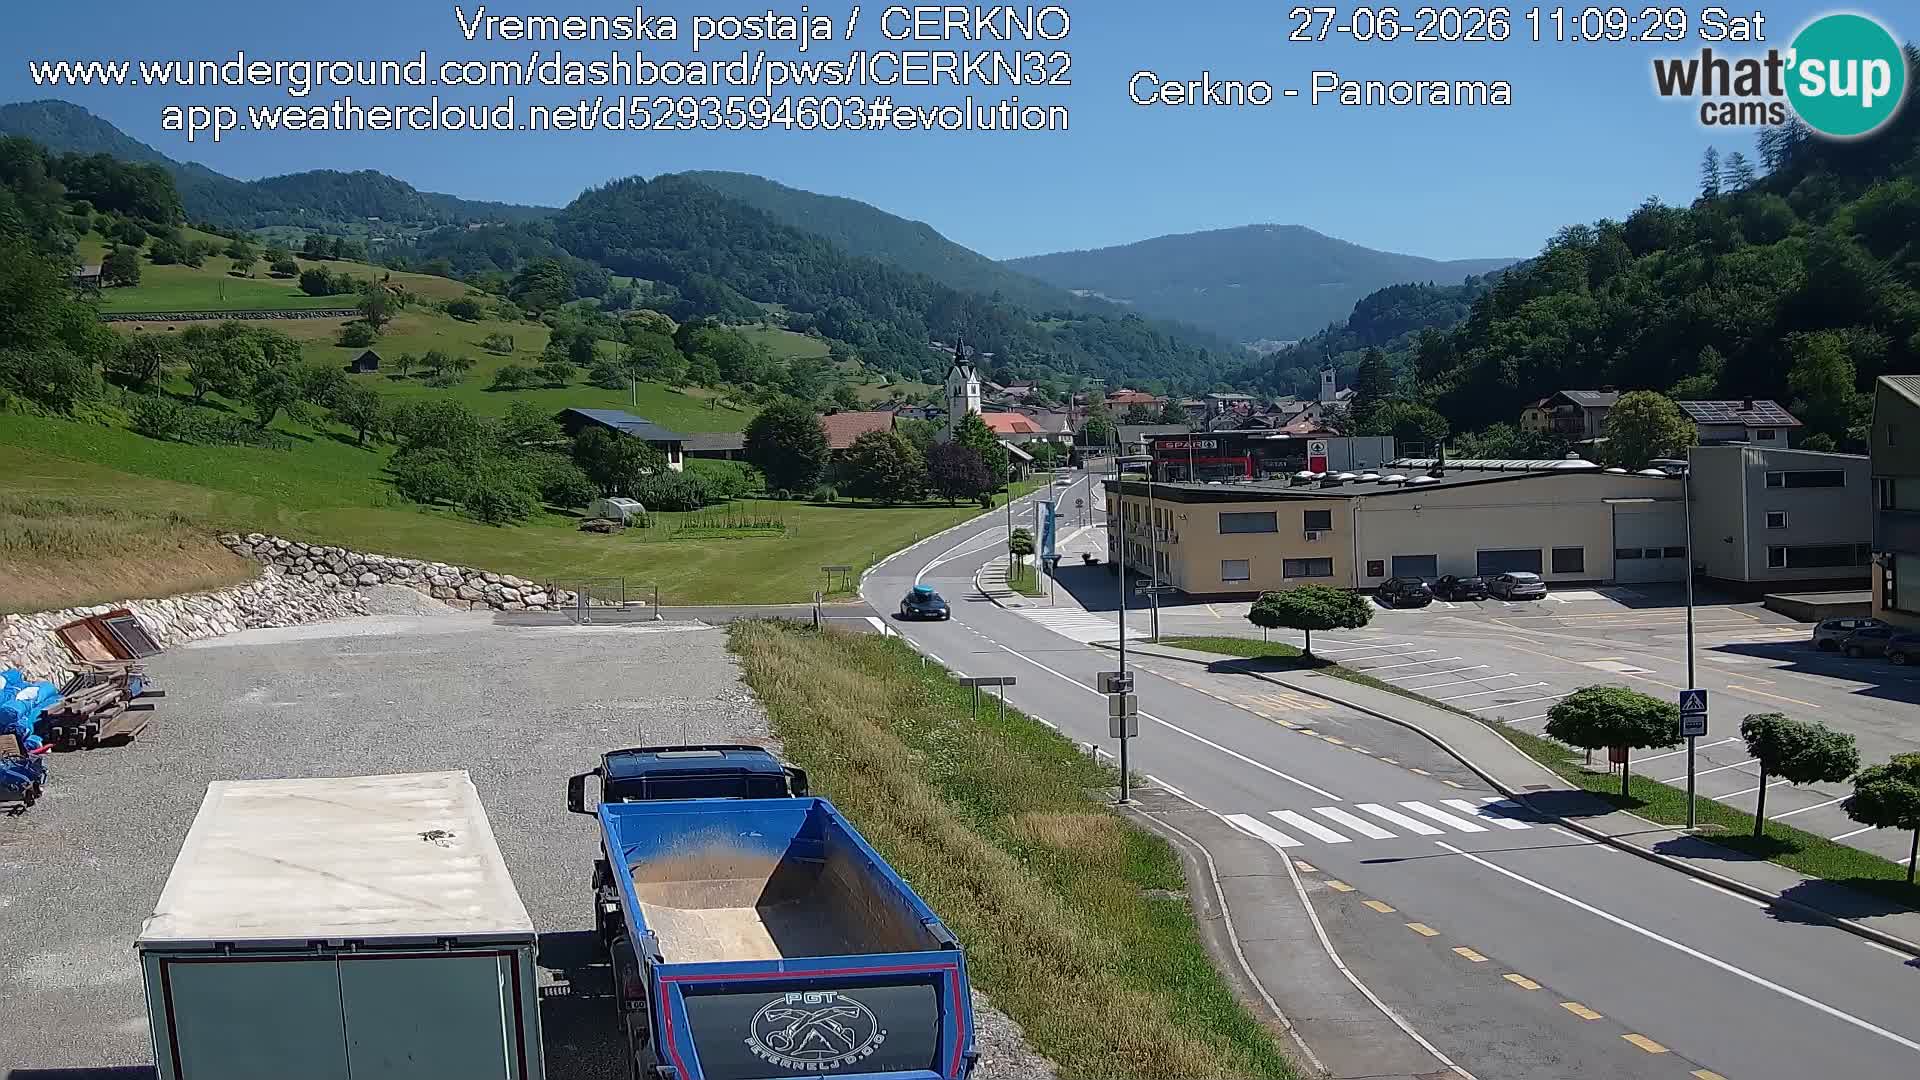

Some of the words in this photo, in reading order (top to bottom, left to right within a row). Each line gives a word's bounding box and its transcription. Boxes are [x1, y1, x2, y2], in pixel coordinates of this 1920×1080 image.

[1165, 441, 1201, 449] SPAR
[784, 991, 838, 1005] PGT
[743, 1037, 840, 1071] PETERNELJ
